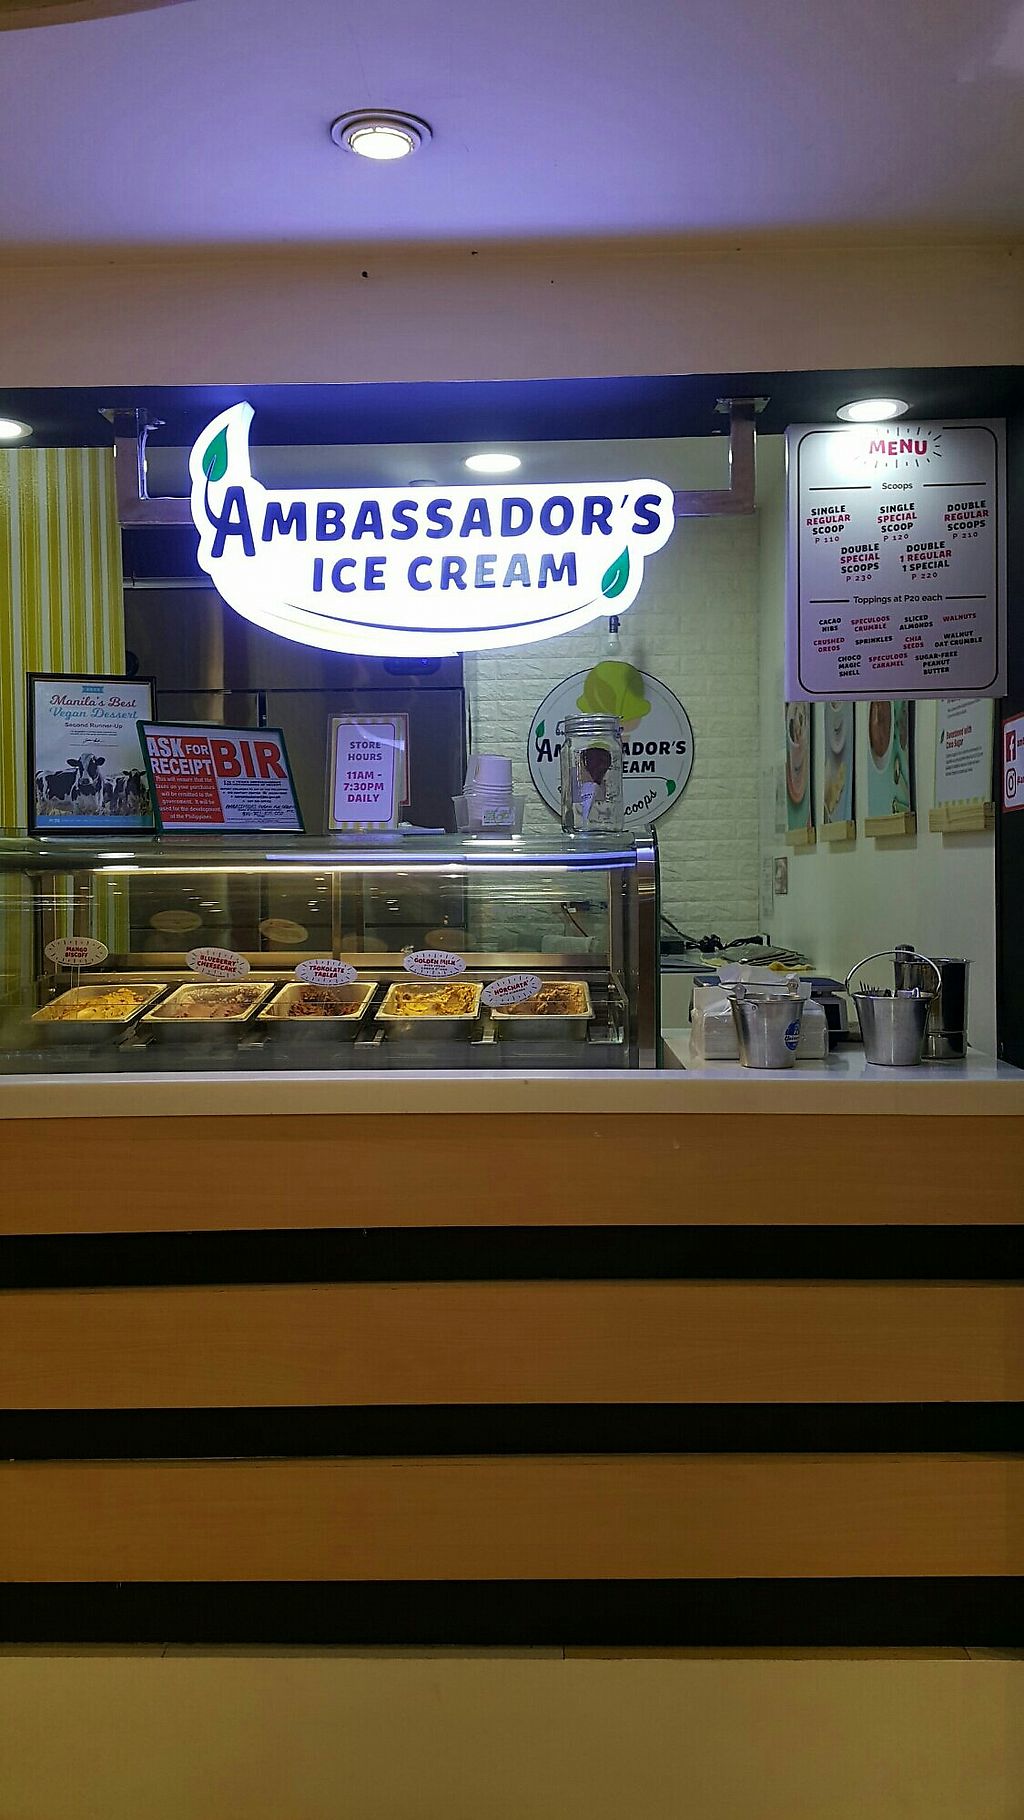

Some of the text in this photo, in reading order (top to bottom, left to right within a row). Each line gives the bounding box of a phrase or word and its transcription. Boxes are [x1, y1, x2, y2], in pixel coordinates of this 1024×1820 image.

[869, 438, 928, 456] MENU
[881, 482, 913, 491] Scoops
[811, 505, 846, 516] SINGLE
[879, 503, 915, 514] SINGLE
[947, 500, 986, 512] DOUBLE
[806, 514, 851, 526] REGULAR
[877, 512, 917, 523] SPECIAL
[944, 509, 989, 522] REGULAR
[211, 486, 662, 558] AMBASSADOR'S
[947, 520, 986, 531] SCOOPS
[812, 524, 845, 535] SCOOP
[881, 522, 914, 533] SCOOP
[892, 533, 909, 541] 120
[962, 531, 978, 539] 210
[841, 543, 880, 555] DOUBLE
[906, 540, 946, 553] DOUBLE
[840, 553, 880, 564] SPECIAL
[900, 549, 952, 563] 1 REGULAR
[841, 562, 880, 574] SCOOPS
[902, 559, 950, 572] 1 SPECIAL
[312, 551, 578, 593] ICE CREAM
[921, 571, 938, 579] 220
[856, 574, 872, 582] 230
[853, 593, 943, 605] Toppings at P20 each
[819, 617, 842, 626] CACAO
[850, 615, 890, 625] SPECULOOS
[904, 614, 929, 623] SLICED
[942, 613, 977, 623] WALNUTS
[821, 624, 838, 633] NIBS
[854, 623, 887, 632] CRUMBLE
[899, 621, 934, 631] ALMONDS
[855, 635, 893, 645] SPRINKLES
[904, 635, 922, 643] CHIA
[943, 630, 974, 640] WALNUT
[813, 637, 845, 646] CRUSHED
[902, 641, 924, 650] SEEDS
[934, 637, 982, 648] OAT CRUMBLE
[817, 645, 841, 653] OREOS
[838, 654, 862, 663] CHOCO
[868, 652, 908, 663] SPECULOOS
[914, 650, 958, 661] SUGAR-FREE
[838, 661, 861, 670] MAGIC
[872, 660, 904, 669] CARAMEL
[922, 659, 950, 668] PEANUT
[839, 669, 860, 678] SHELL
[923, 666, 950, 676] BUTTER
[49, 694, 137, 708] Manila's Best
[50, 707, 139, 721] Vegan Dessert
[146, 737, 210, 758] ASK FOR
[350, 741, 381, 749] STORE
[209, 739, 288, 779] BIR
[347, 753, 382, 761] HOURS
[150, 758, 213, 776] RECEIPT
[346, 771, 374, 780] 11AM
[343, 782, 384, 791] 7:30PM
[347, 794, 380, 803] DAILY
[623, 789, 657, 816] coops
[200, 954, 237, 967] BLUEBERRY
[413, 957, 439, 965] GOLDEN
[196, 960, 237, 973] CHEESECAKE
[309, 965, 345, 974] TSOKOLATE
[314, 971, 338, 979] TABLEA
